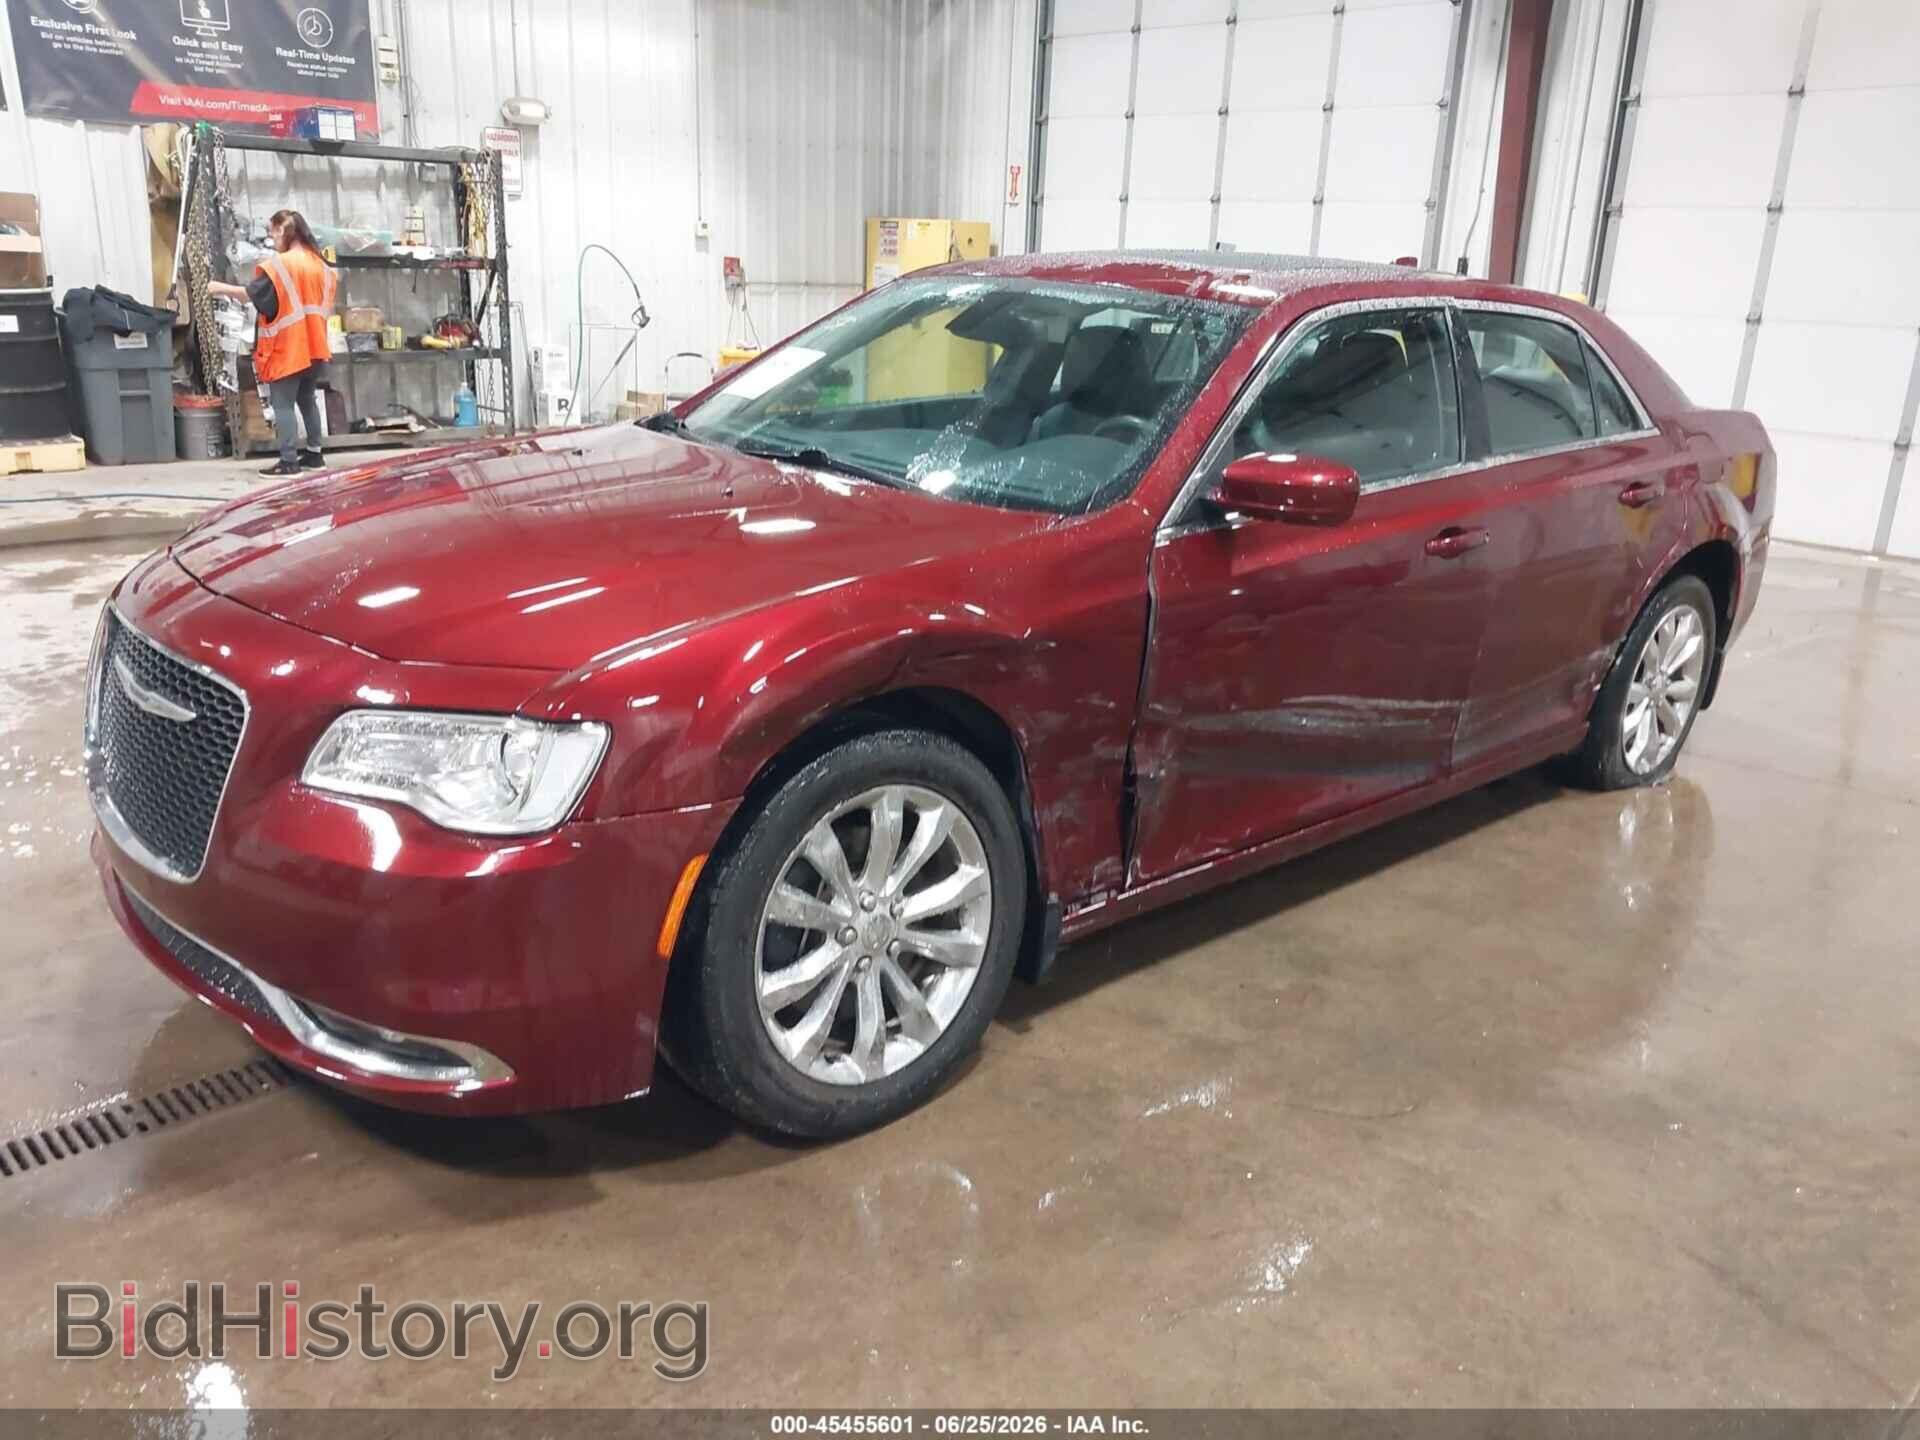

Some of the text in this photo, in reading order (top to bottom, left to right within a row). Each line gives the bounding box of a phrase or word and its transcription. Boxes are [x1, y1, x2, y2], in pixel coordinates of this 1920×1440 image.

[30, 15, 83, 33] Exclusive
[85, 23, 110, 37] First
[172, 35, 244, 54] Quick and Easy
[275, 46, 356, 65] Real-Time Updates
[159, 94, 181, 106] Visit
